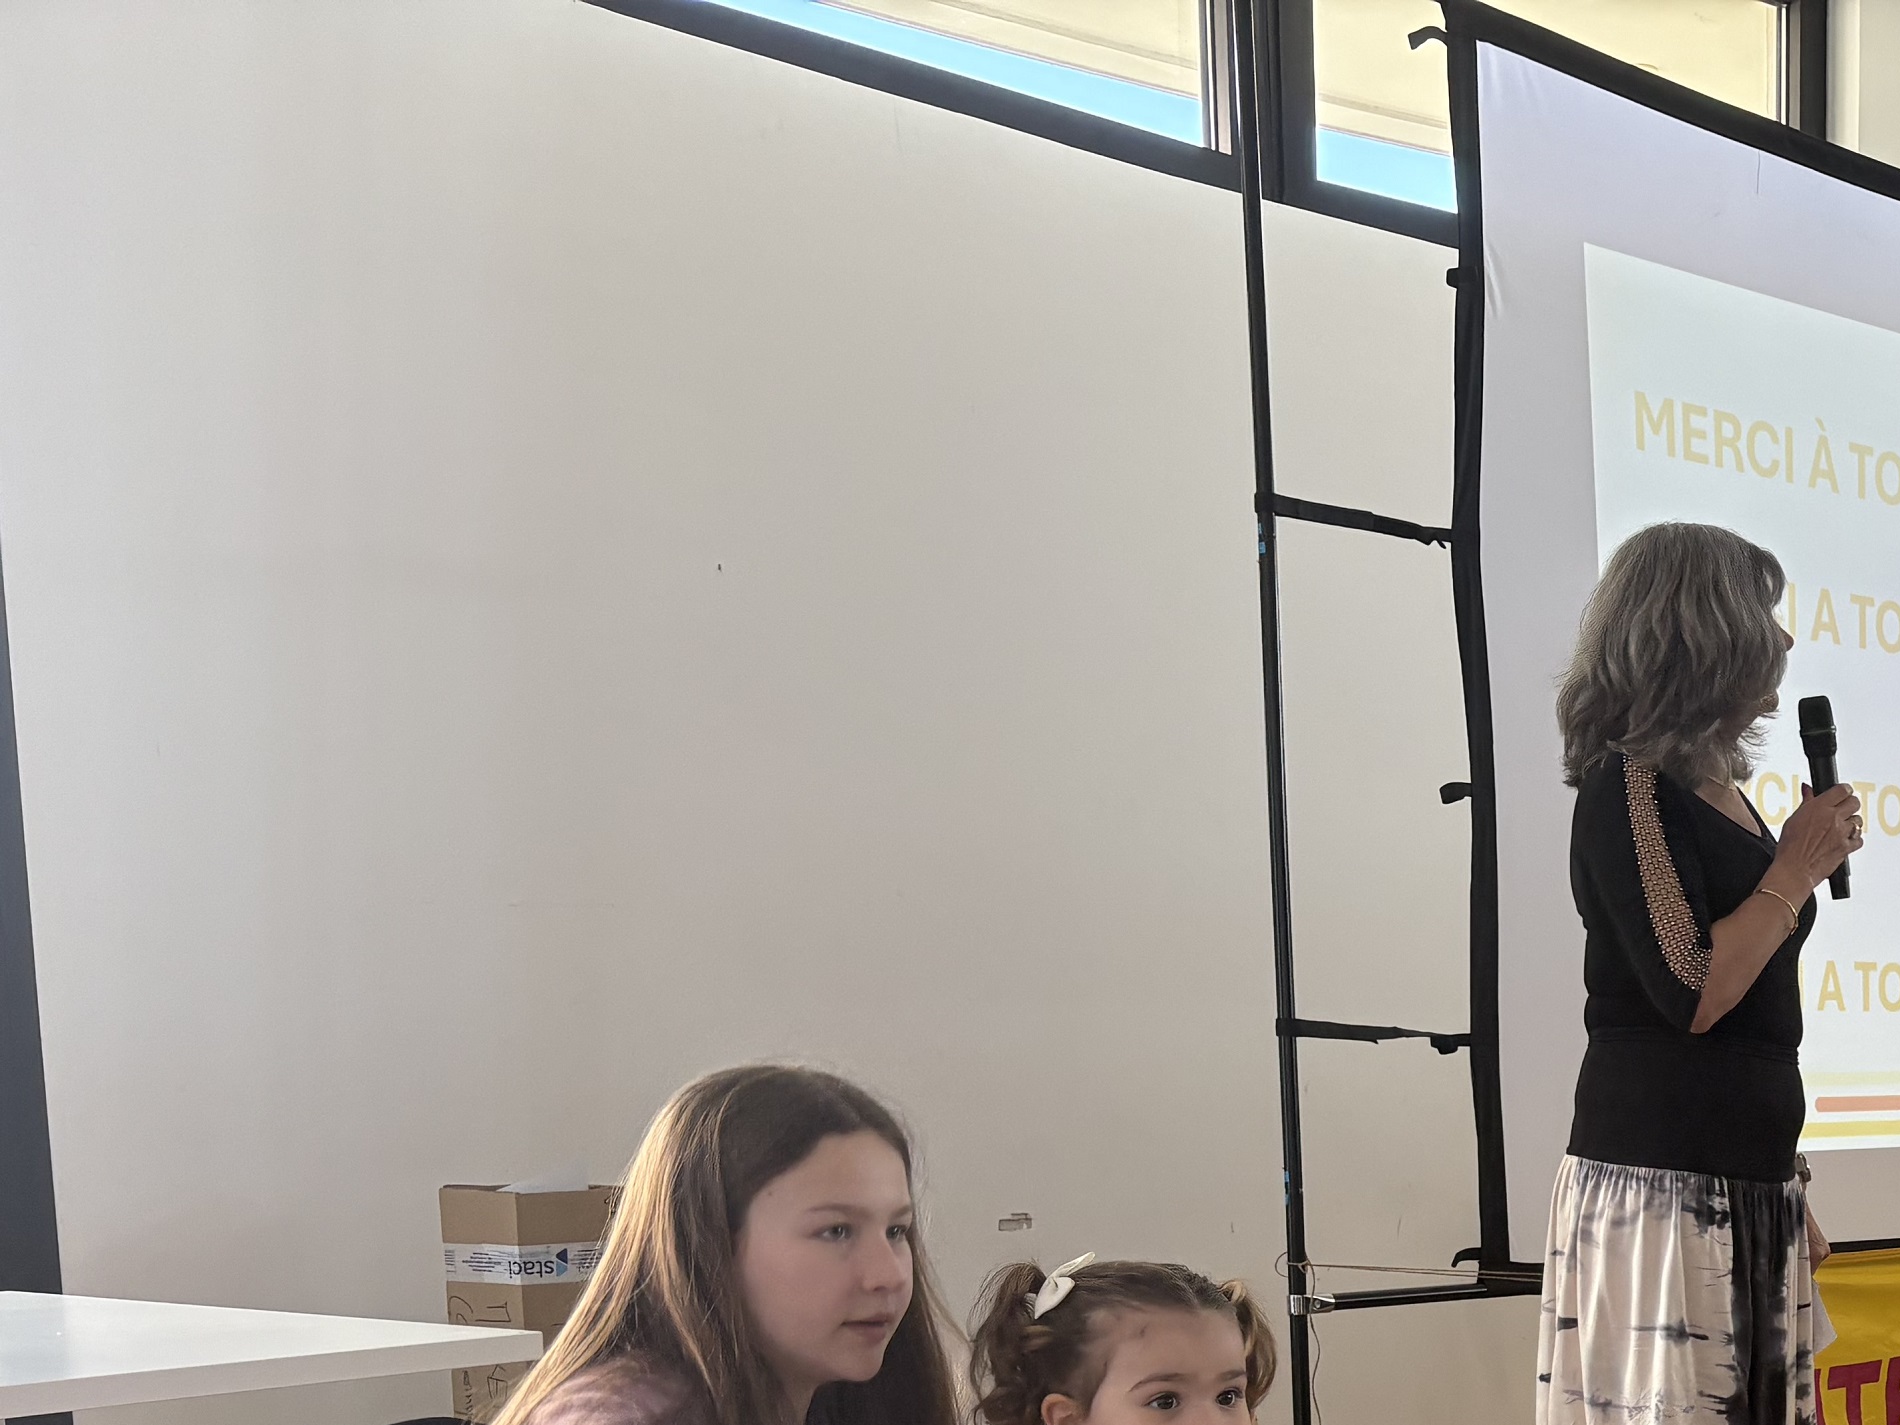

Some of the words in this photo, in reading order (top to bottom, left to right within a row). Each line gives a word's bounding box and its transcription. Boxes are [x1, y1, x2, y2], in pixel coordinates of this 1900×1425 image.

[1634, 390, 1794, 484] MERCI
[1807, 416, 1840, 494] À
[1810, 588, 1841, 645] A
[1817, 960, 1846, 1011] A
[508, 1260, 555, 1278] staci
